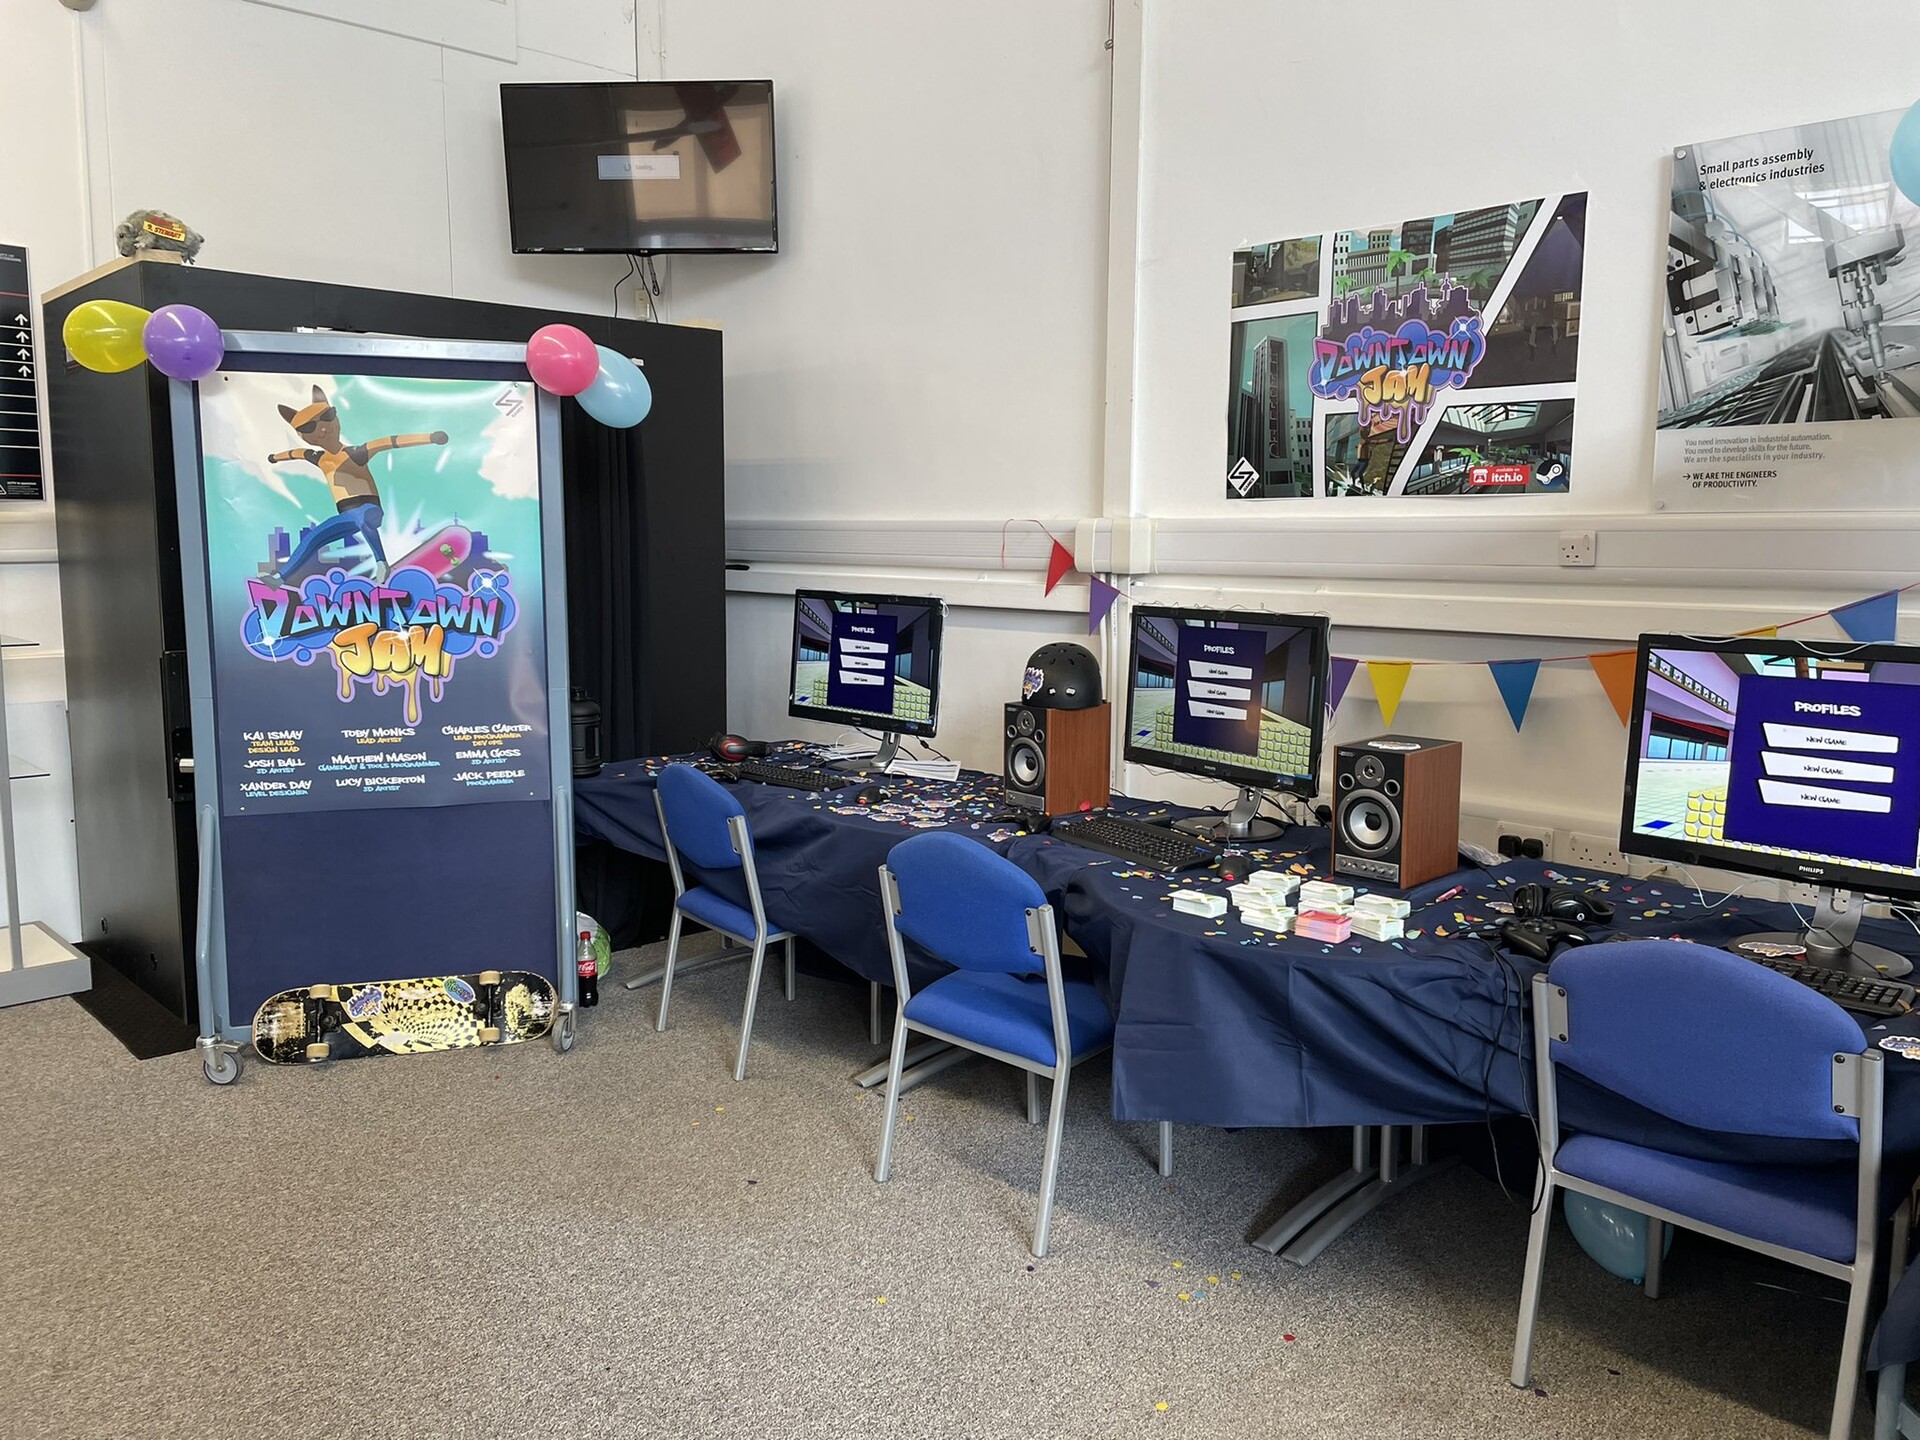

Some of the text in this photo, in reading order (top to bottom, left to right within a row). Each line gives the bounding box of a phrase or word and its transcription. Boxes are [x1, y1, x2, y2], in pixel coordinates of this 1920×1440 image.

[1700, 148, 1814, 175] Small parts assembly
[1699, 163, 1825, 191] & electronics industries
[1315, 337, 1470, 381] DOWNTOWN
[1360, 363, 1430, 405] JAM
[1698, 438, 1714, 446] need
[1758, 435, 1790, 443] industrial
[1790, 433, 1833, 442] automation.
[1685, 447, 1697, 455] You
[1721, 446, 1746, 455] develop
[1748, 445, 1766, 453] skills
[1766, 444, 1776, 452] for
[1709, 455, 1720, 463] the
[1722, 454, 1762, 464] specialists
[1763, 453, 1771, 461] in
[1772, 454, 1789, 462] your
[1791, 451, 1825, 461] industry.
[1491, 472, 1523, 483] itch.io
[1693, 470, 1777, 480] WE ARE THE ENGINEERS
[1692, 480, 1758, 489] OF PRODUCTIVITY.
[248, 580, 504, 637] DOWNTOWN
[333, 622, 445, 676] JAM
[1203, 645, 1235, 655] PROFILES
[1794, 701, 1862, 717] PROFILES
[341, 727, 416, 738] TOBY MONKS
[442, 724, 532, 735] CHARLES CARTER
[243, 730, 304, 741] KAI ISMAY
[1806, 736, 1848, 746] NEW GAME
[331, 752, 427, 764] MATTHEW MASON
[455, 748, 521, 759] EMMA GOSS
[244, 758, 306, 768] JOSH BALL
[318, 763, 358, 771] GAMEPLAY
[453, 770, 525, 781] JACK PEEDLE
[1804, 765, 1844, 775] NEW GAME
[240, 780, 312, 791] XANDER DAY
[336, 774, 426, 787] LUCY BICKERTON
[269, 789, 308, 797] DESIGNER
[1801, 793, 1841, 805] NEW GAME
[1798, 865, 1824, 875] PHILIPS
